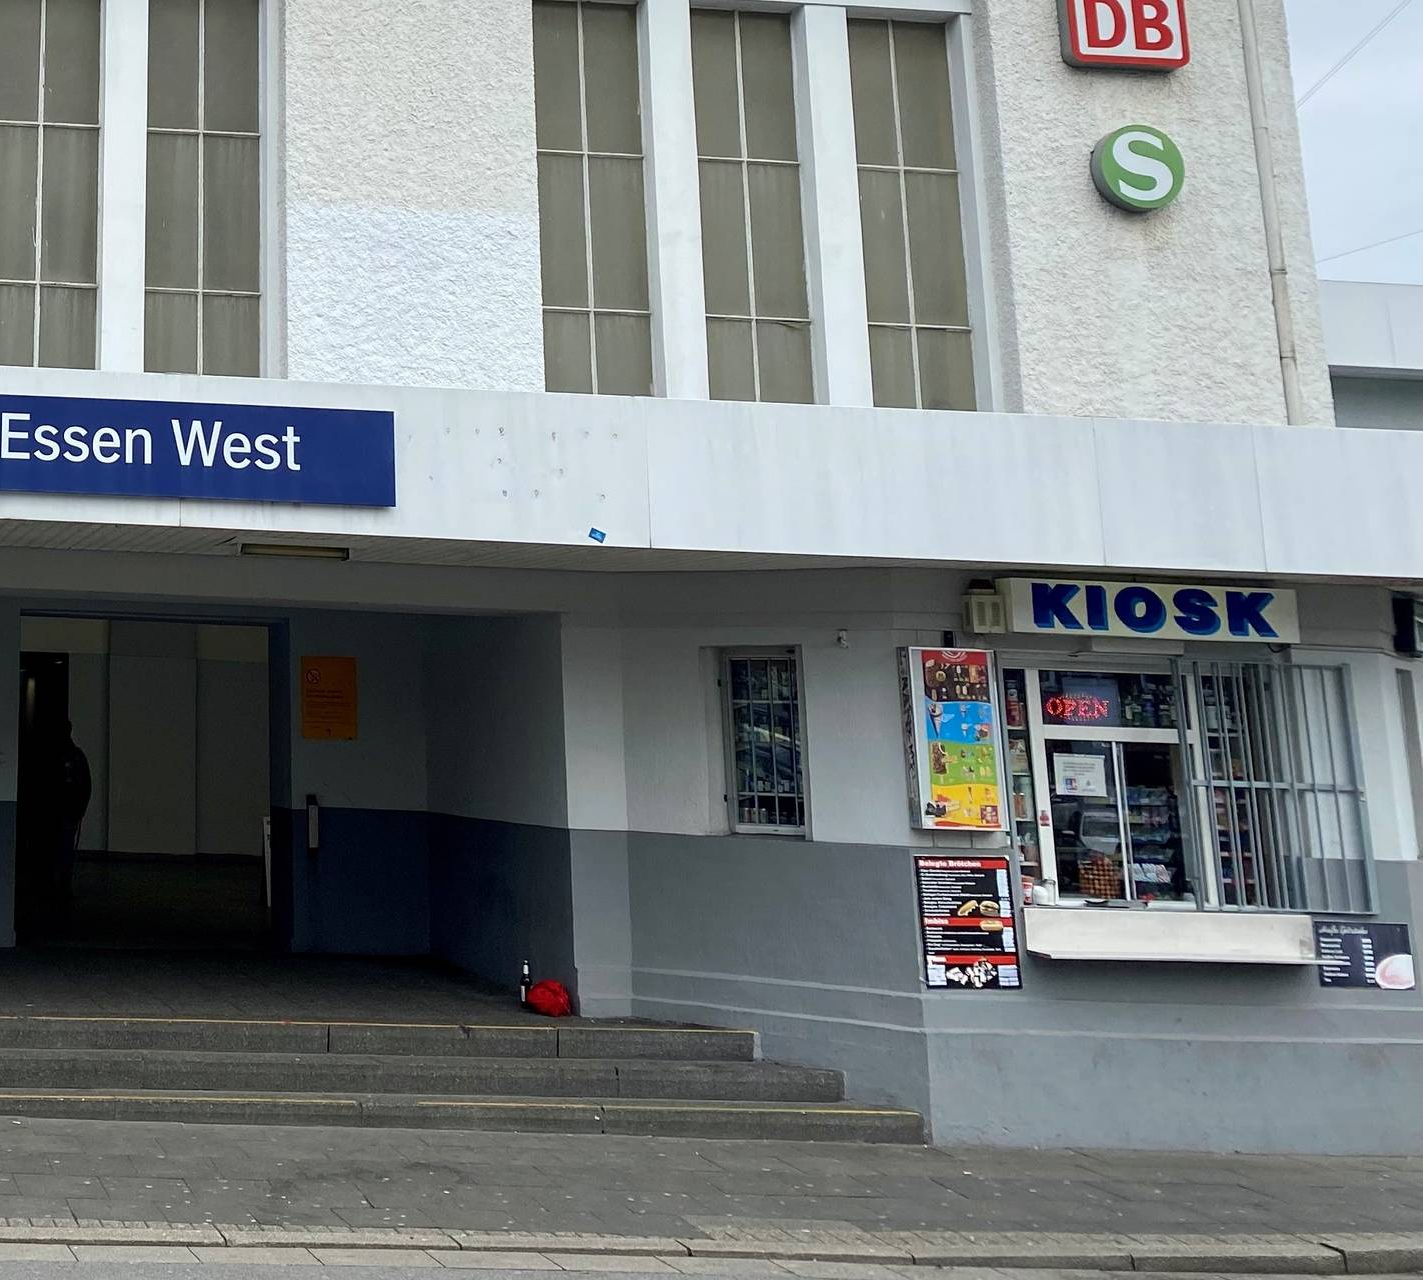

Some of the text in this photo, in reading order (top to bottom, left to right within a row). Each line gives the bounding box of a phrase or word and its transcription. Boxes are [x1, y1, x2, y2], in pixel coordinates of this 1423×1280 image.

[1083, 0, 1173, 50] DB
[1112, 131, 1174, 202] S
[0, 411, 302, 472] Essen West
[1031, 582, 1280, 638] KIOSK
[1045, 697, 1110, 718] OPEN
